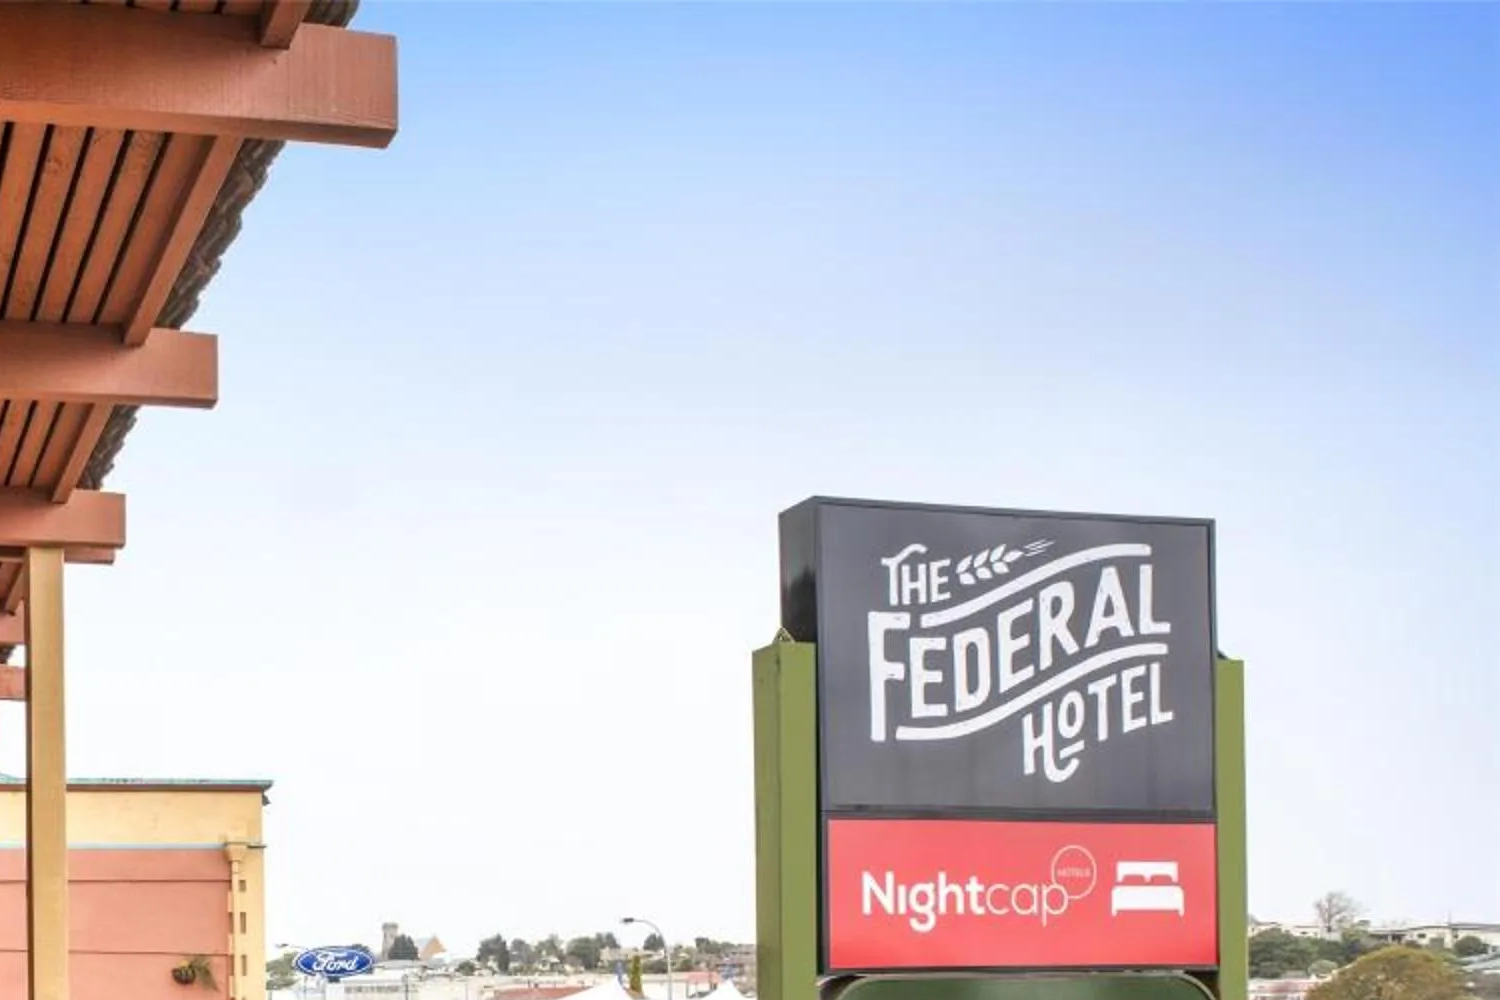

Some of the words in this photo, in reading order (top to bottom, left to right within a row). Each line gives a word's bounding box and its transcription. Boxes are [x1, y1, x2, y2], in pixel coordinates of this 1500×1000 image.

[880, 543, 952, 607] THE
[867, 563, 1172, 743] FEDERAL
[1021, 661, 1175, 783] HOTEL
[861, 870, 1069, 934] Nightcap
[312, 951, 359, 972] Ford
